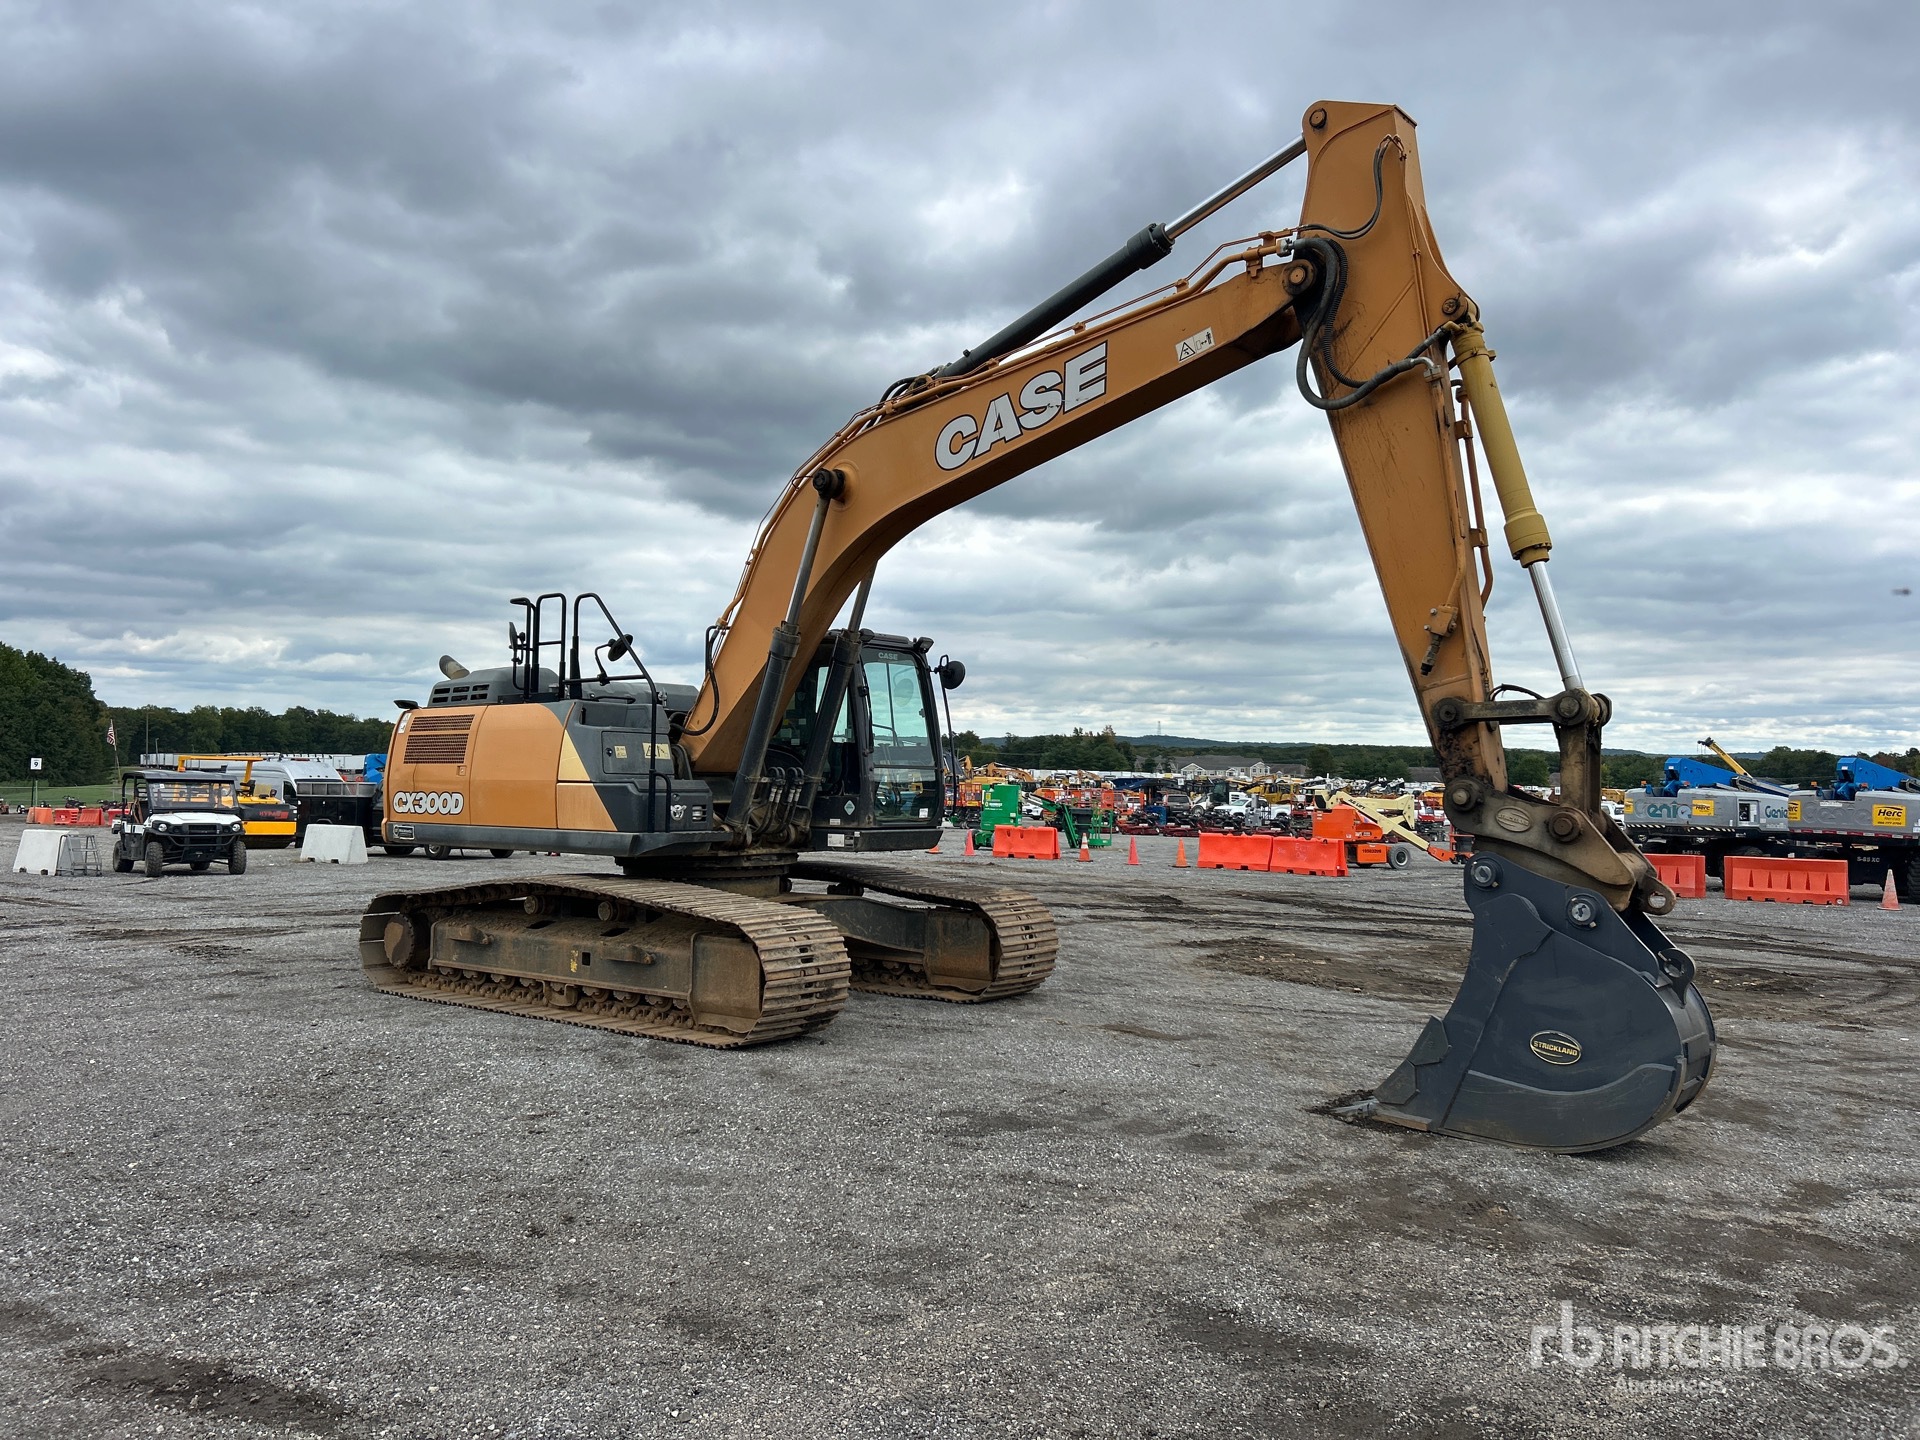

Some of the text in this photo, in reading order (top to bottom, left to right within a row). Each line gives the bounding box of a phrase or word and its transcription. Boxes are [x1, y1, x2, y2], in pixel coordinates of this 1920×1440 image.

[935, 340, 1108, 471] CASE
[878, 652, 898, 660] CASE
[393, 791, 464, 815] CX300D
[1878, 809, 1903, 817] Herc
[1533, 1040, 1578, 1056] STRICKLAND
